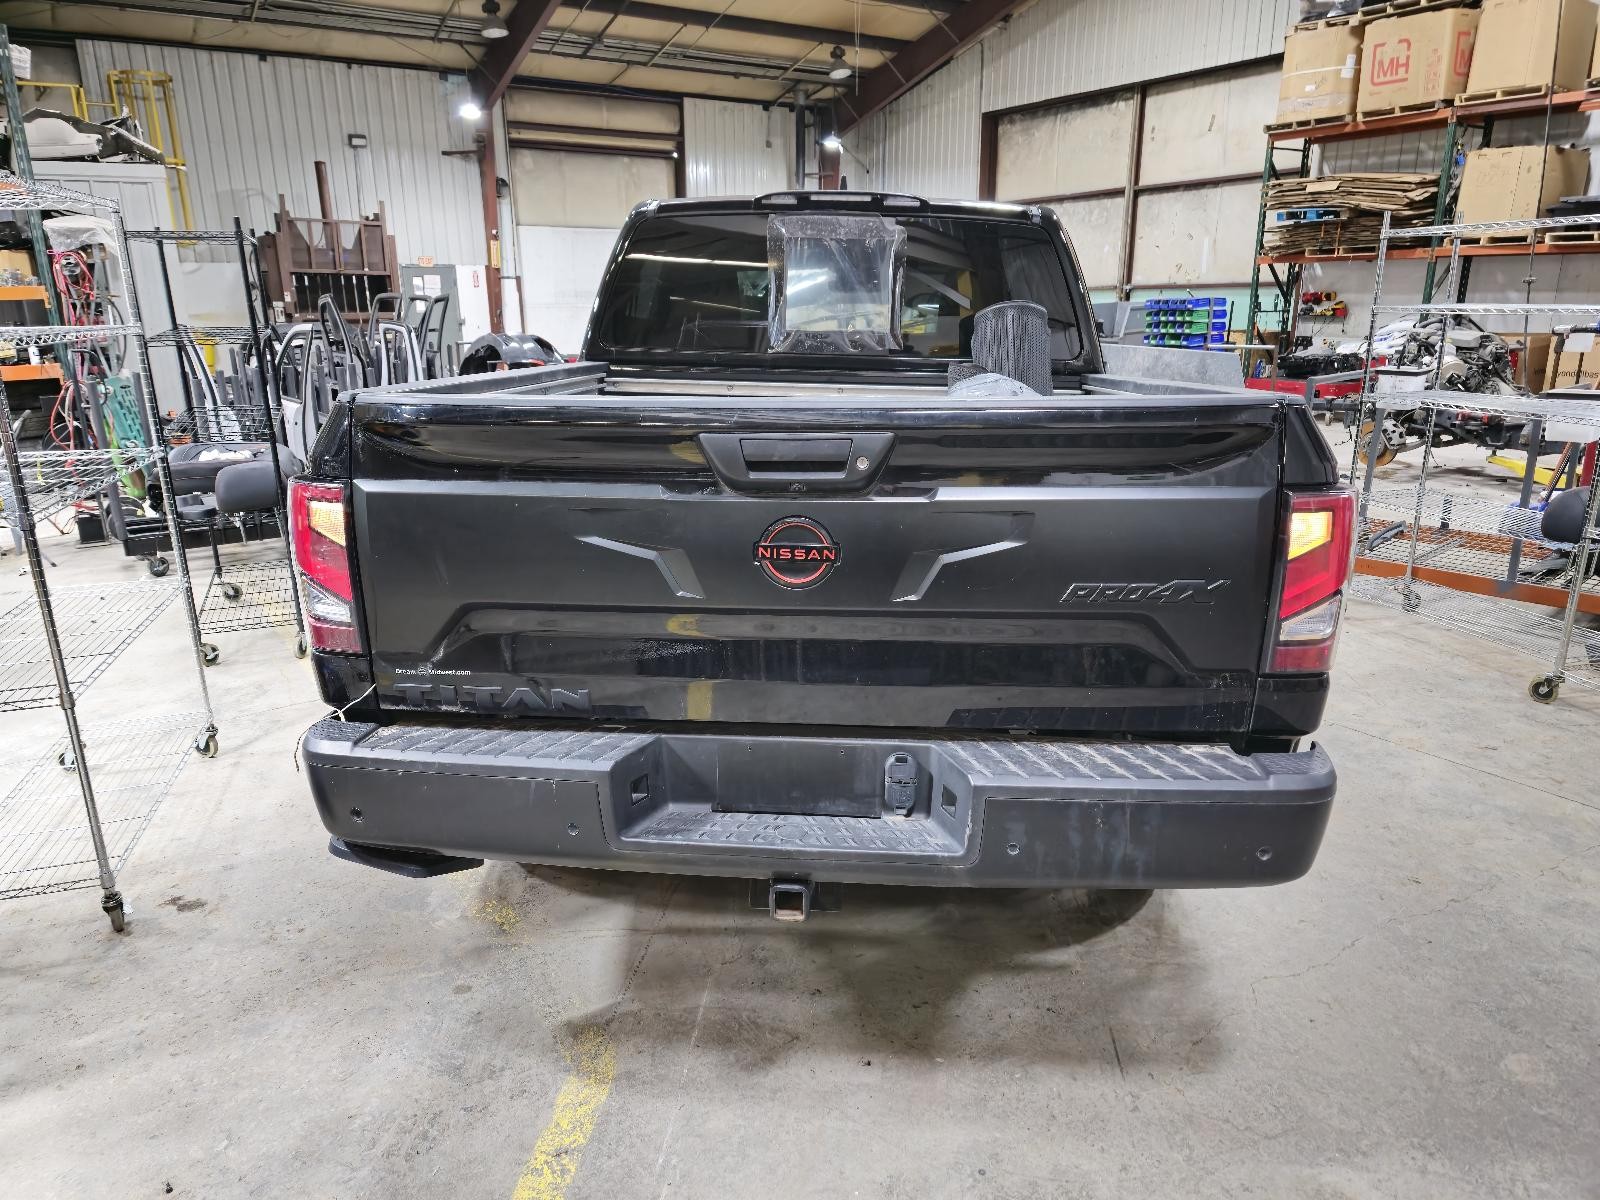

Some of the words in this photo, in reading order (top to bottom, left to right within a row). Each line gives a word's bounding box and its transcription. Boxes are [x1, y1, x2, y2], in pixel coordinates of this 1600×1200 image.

[1376, 54, 1411, 79] MH
[758, 546, 835, 560] NISSAN
[393, 683, 591, 712] TITAN
